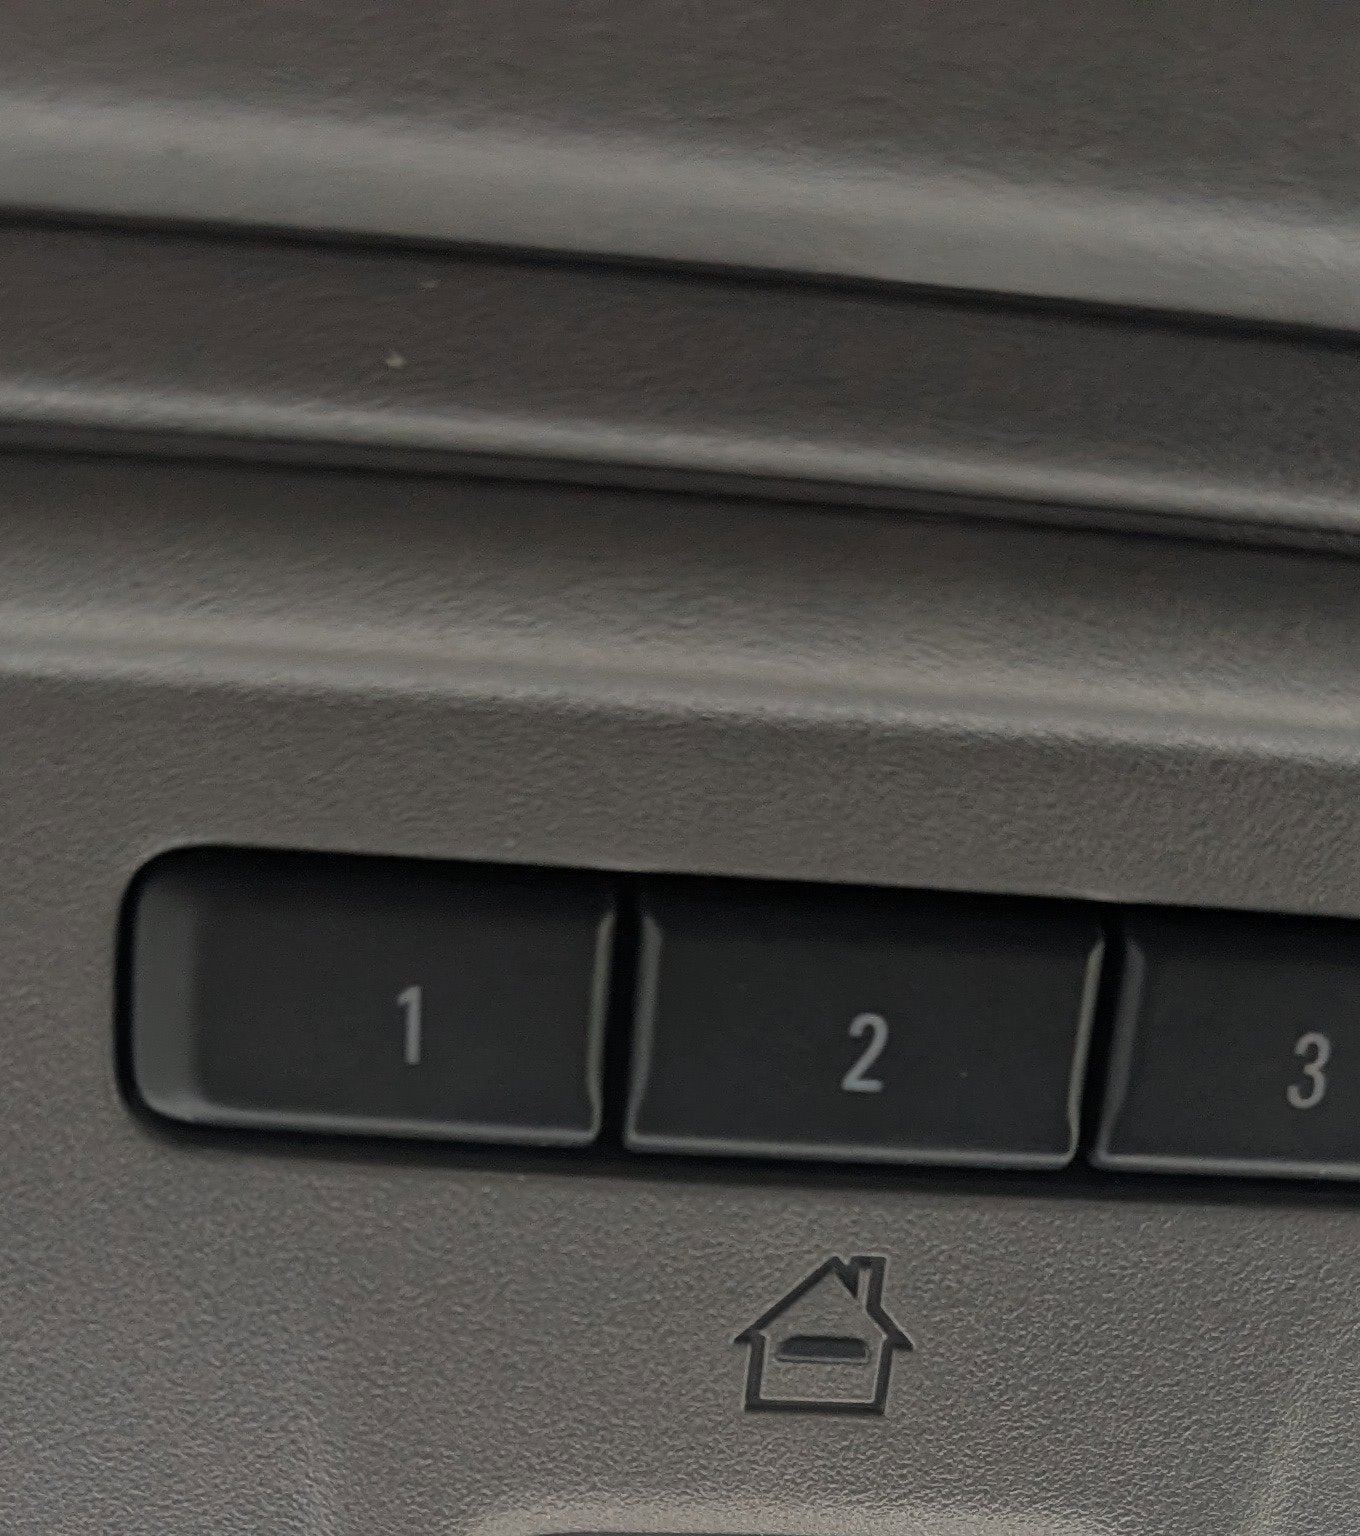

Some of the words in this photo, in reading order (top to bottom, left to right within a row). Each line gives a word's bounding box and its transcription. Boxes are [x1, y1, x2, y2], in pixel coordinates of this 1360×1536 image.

[395, 984, 424, 1066] 1
[841, 1013, 890, 1093] 2
[1286, 1032, 1332, 1109] 3
